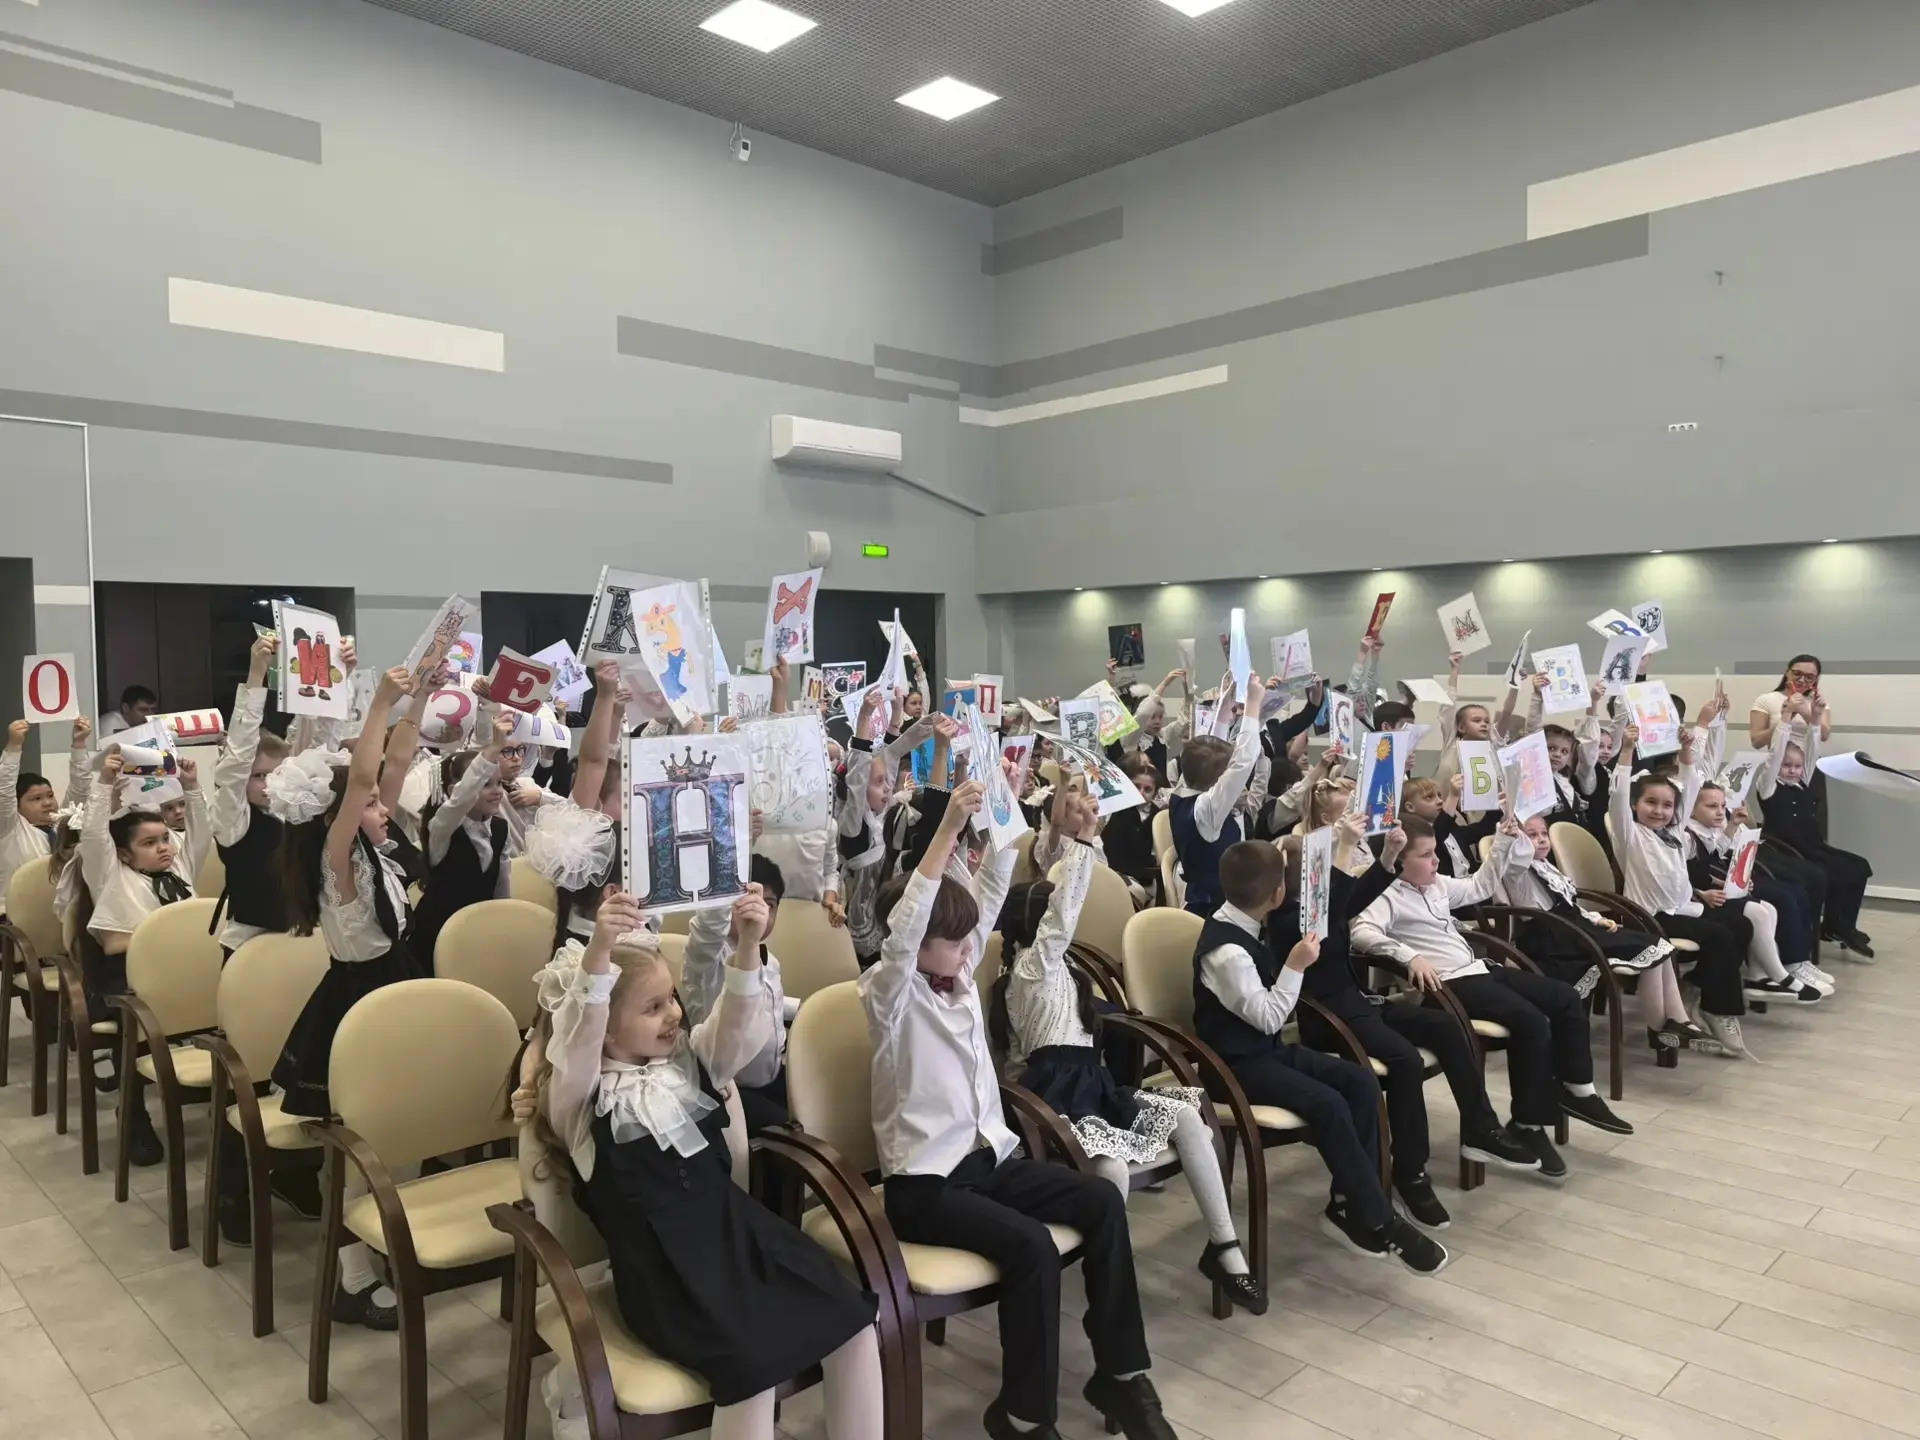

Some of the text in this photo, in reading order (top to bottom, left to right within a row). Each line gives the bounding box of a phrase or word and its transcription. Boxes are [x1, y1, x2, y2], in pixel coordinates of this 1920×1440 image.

[774, 577, 813, 624] Х
[1455, 609, 1480, 637] М
[490, 654, 551, 713] Е
[1602, 647, 1637, 683] А
[28, 660, 70, 714] О
[979, 684, 996, 713] П
[1470, 757, 1491, 794] Б
[634, 772, 750, 910] Н
